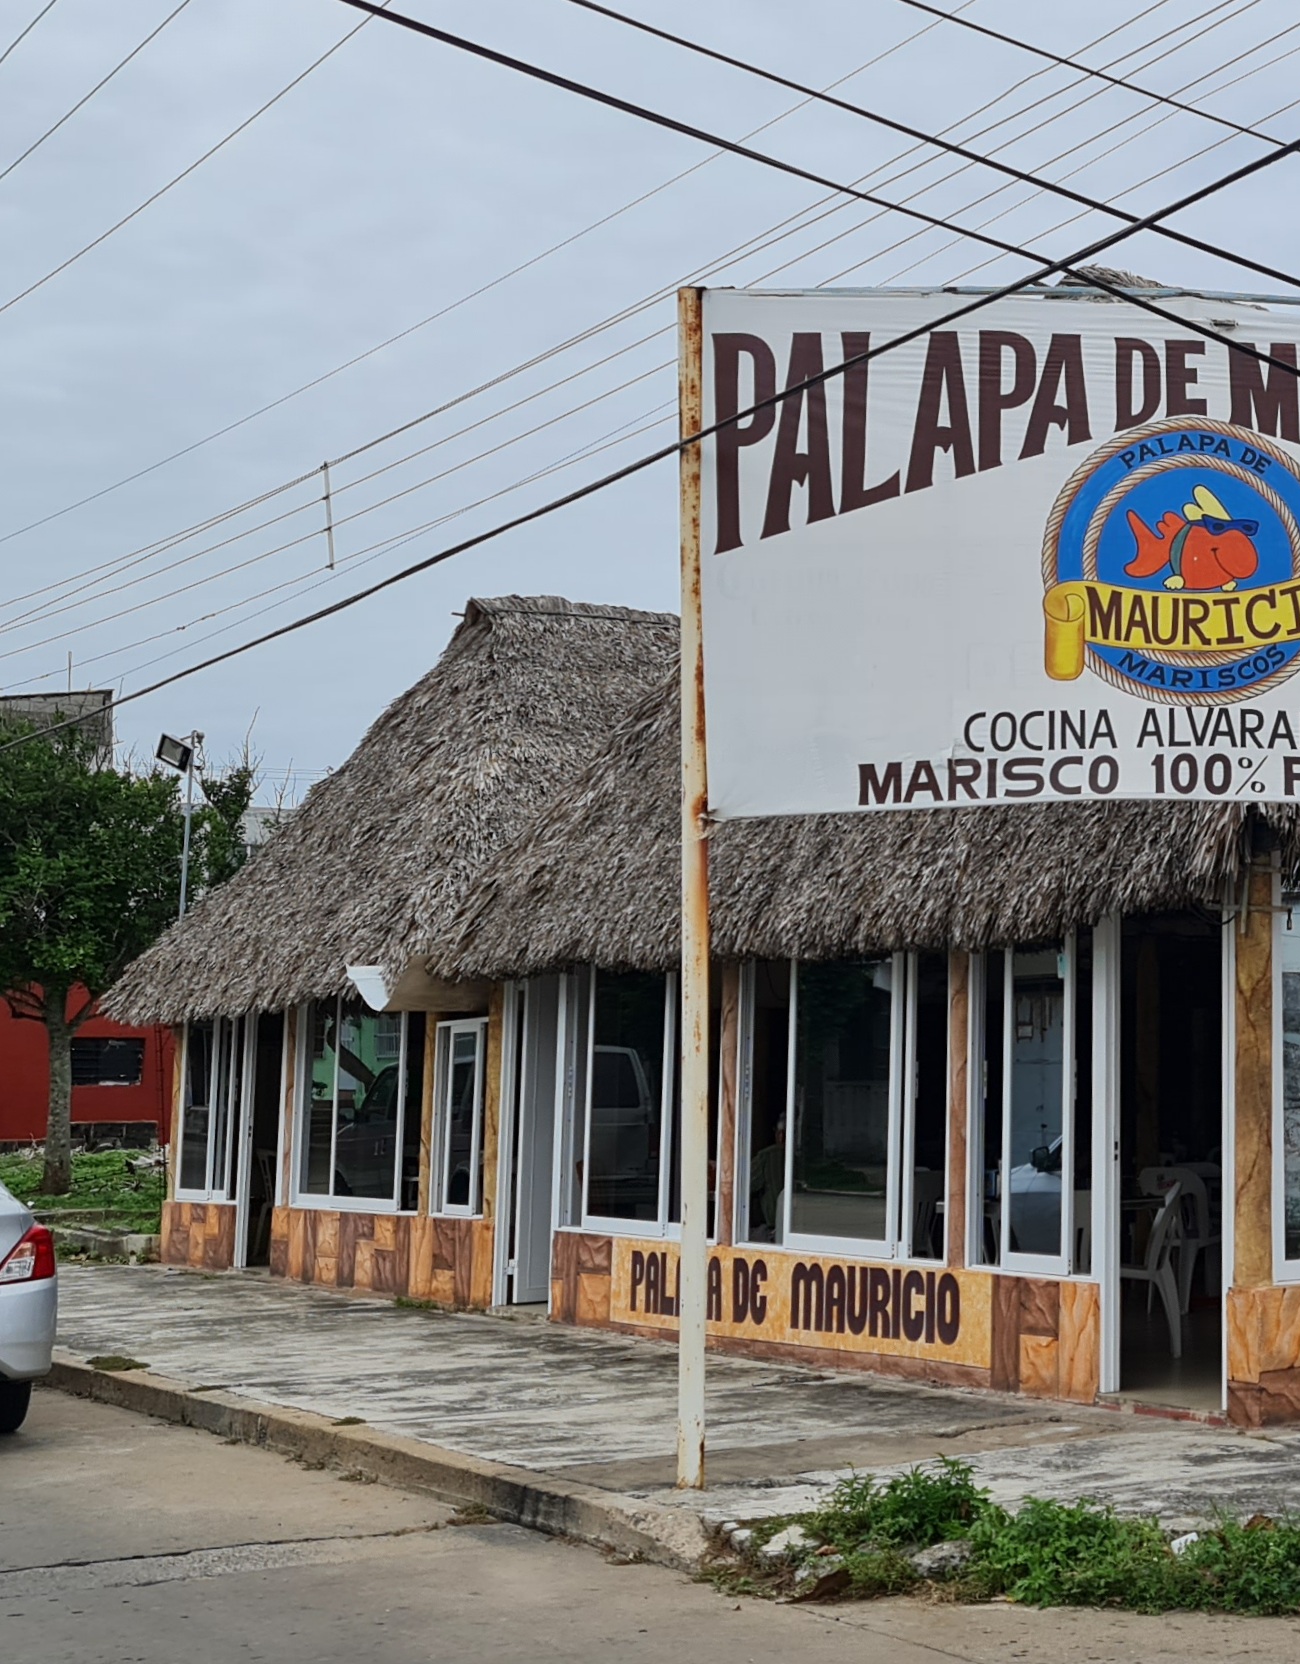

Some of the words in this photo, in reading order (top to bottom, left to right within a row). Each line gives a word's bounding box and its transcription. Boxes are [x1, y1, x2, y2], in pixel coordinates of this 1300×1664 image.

[712, 330, 1093, 555] PALAPA
[1114, 338, 1208, 432] DE
[1117, 434, 1231, 470] PALAPA
[1240, 449, 1272, 474] DE
[1117, 645, 1286, 689] MARISCOS
[963, 708, 1118, 753] COCINA
[858, 755, 1119, 805] MARISCO
[1151, 754, 1268, 796] 100%
[630, 1250, 722, 1322] PALA
[732, 1257, 768, 1326] DE
[790, 1261, 961, 1346] MAURICIO
